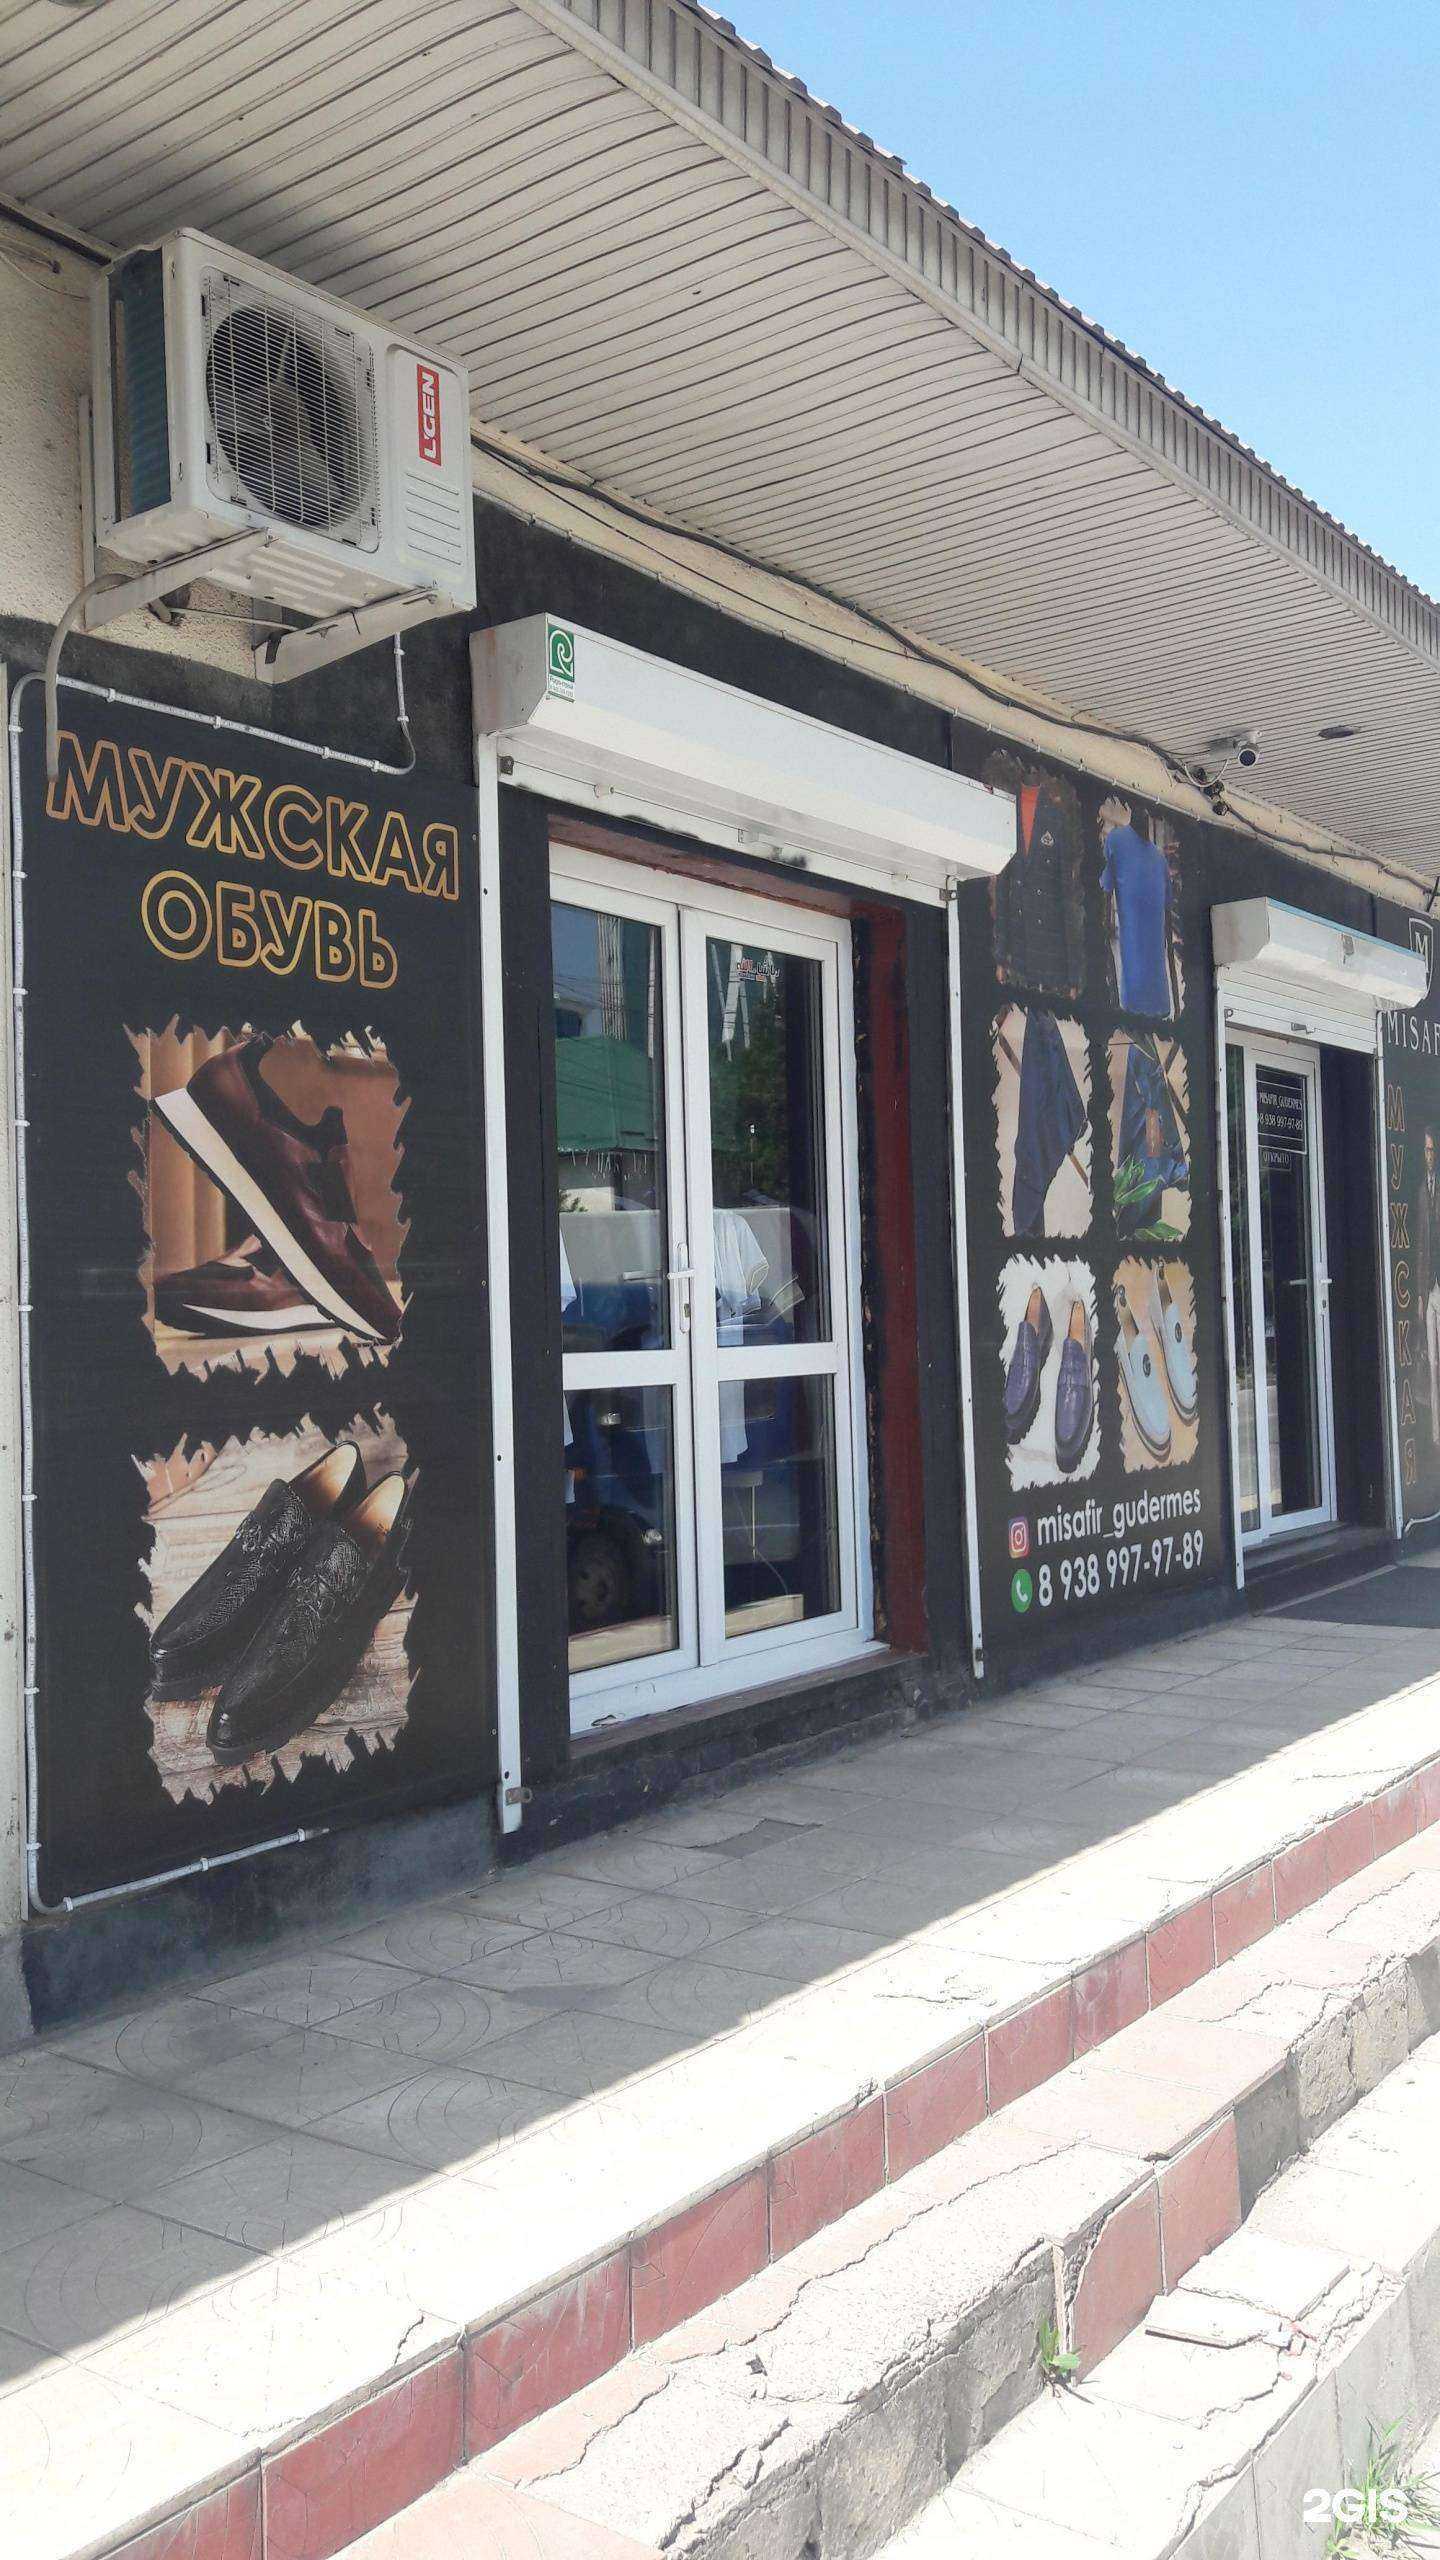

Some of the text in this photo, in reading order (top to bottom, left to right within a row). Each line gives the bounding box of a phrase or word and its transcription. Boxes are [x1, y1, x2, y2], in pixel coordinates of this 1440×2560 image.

[45, 729, 461, 901] МУЖСКАЯ
[140, 869, 399, 990] ОБУВЬ
[1036, 1487, 1202, 1546] misafir_gudermes
[1038, 1529, 1205, 1608] 8 938 997-97-89
